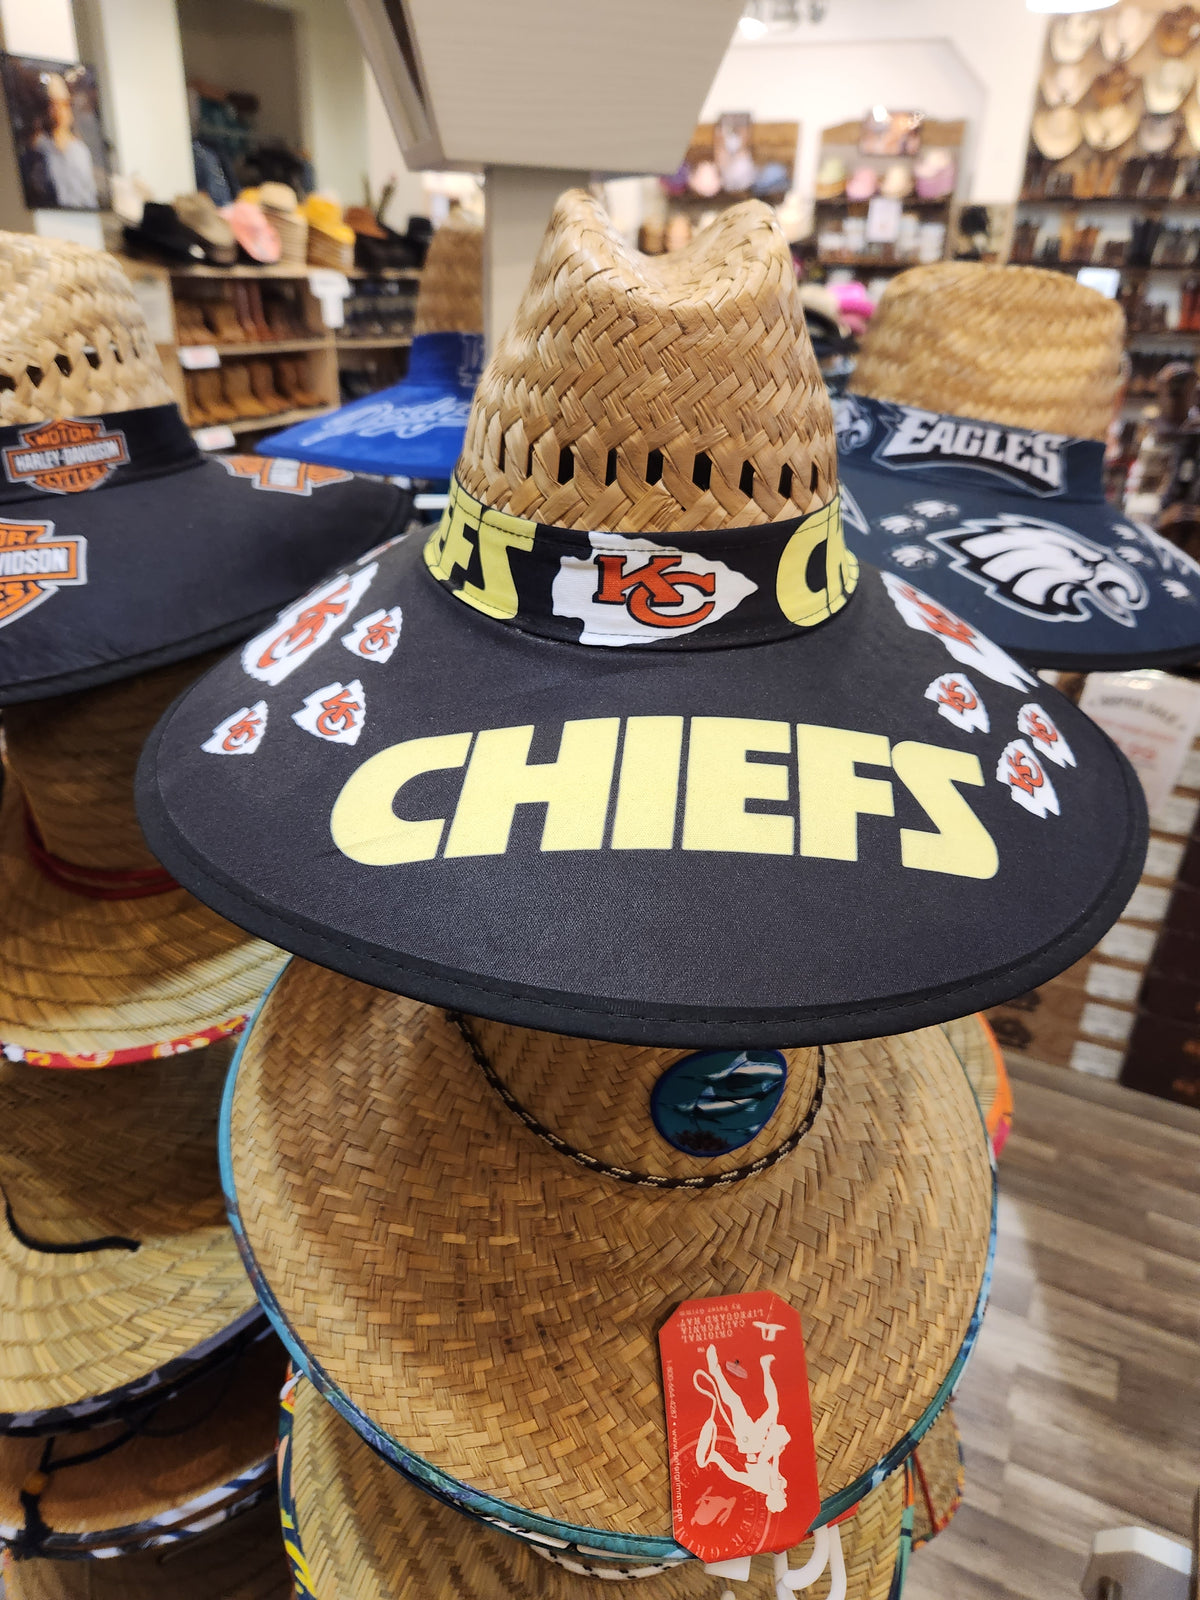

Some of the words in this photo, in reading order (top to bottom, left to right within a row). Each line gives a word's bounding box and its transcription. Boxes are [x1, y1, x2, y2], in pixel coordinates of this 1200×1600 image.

[34, 424, 94, 446] MOTOR
[882, 406, 1068, 489] EAGLES
[13, 440, 120, 473] HARLEY-DAVIDSON
[42, 465, 104, 487] CYCLES
[592, 554, 716, 628] KC
[316, 689, 361, 736] KC
[330, 715, 999, 880] CHIEFS
[680, 1317, 701, 1326] HAT
[680, 1319, 746, 1335] CALIFORNIA
[704, 1308, 765, 1324] LIFEGUARD
[681, 1329, 734, 1344] ORIGINAL
[671, 1428, 685, 1523] www.petergrimm.com
